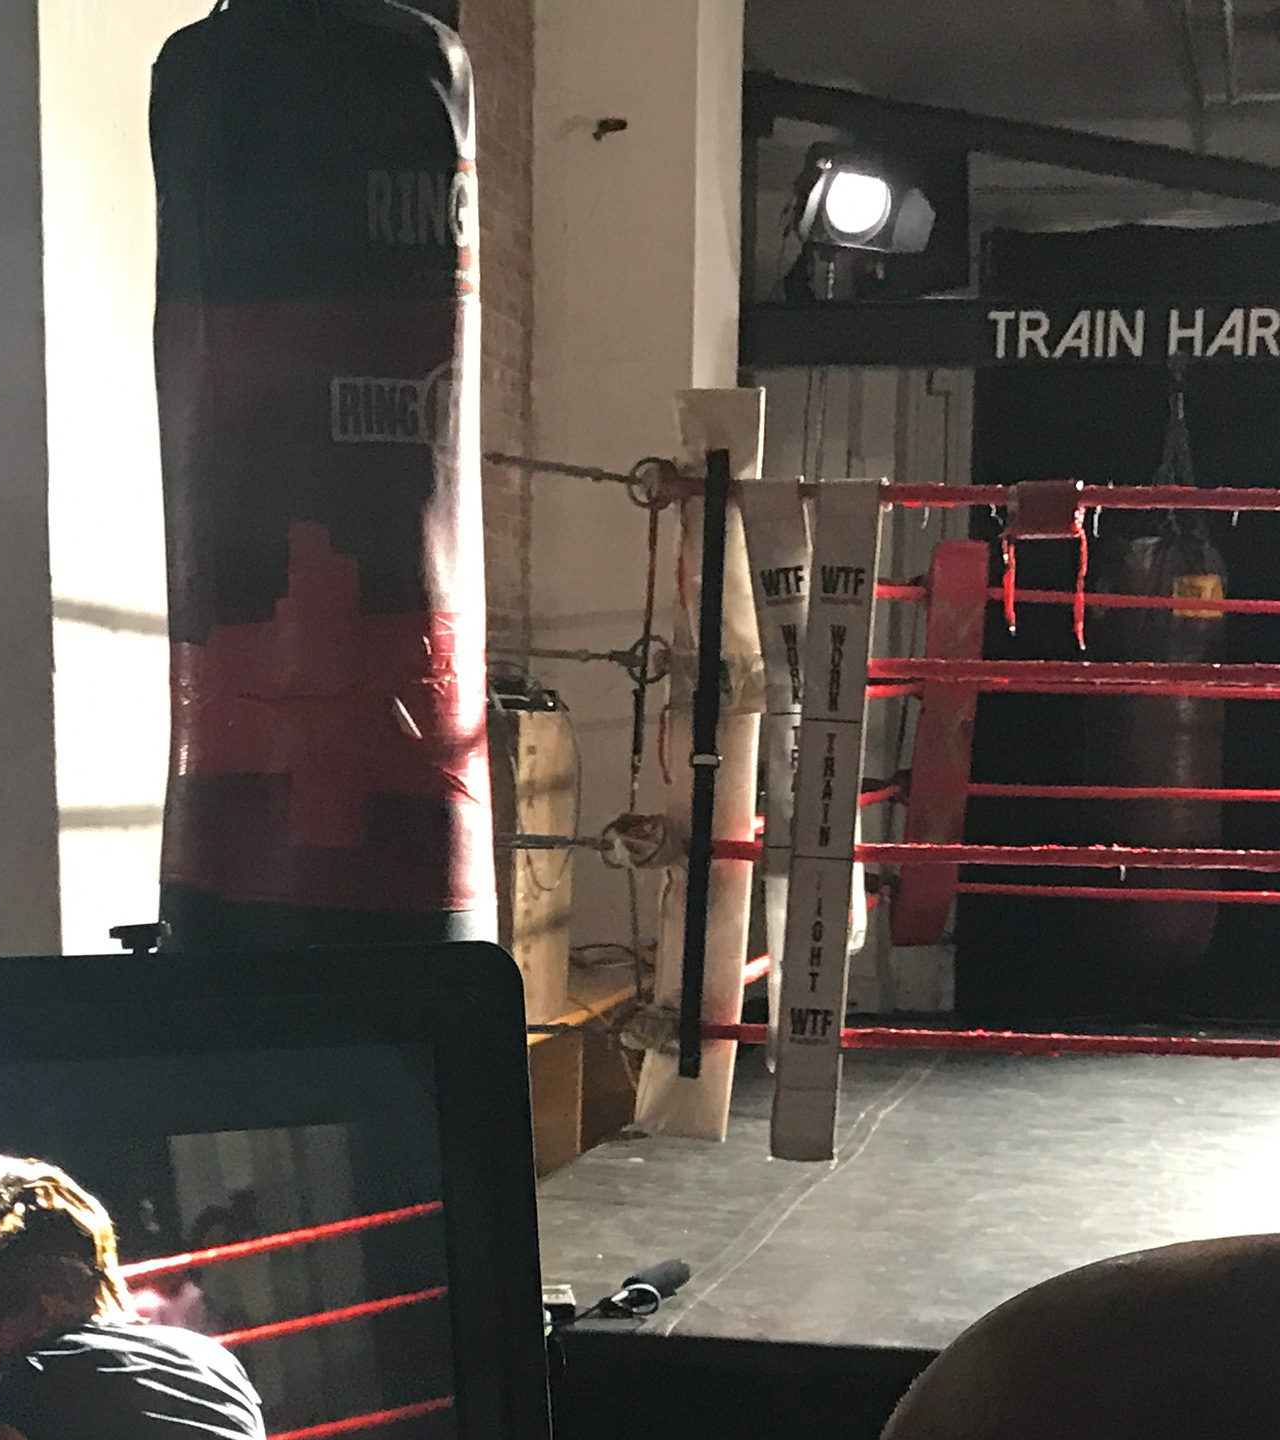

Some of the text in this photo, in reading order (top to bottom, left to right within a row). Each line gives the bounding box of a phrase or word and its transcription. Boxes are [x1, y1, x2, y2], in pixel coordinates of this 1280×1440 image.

[988, 309, 1145, 358] TRAIN
[761, 565, 805, 596] WTF
[820, 565, 865, 596] WTF
[789, 1006, 835, 1037] WTF
